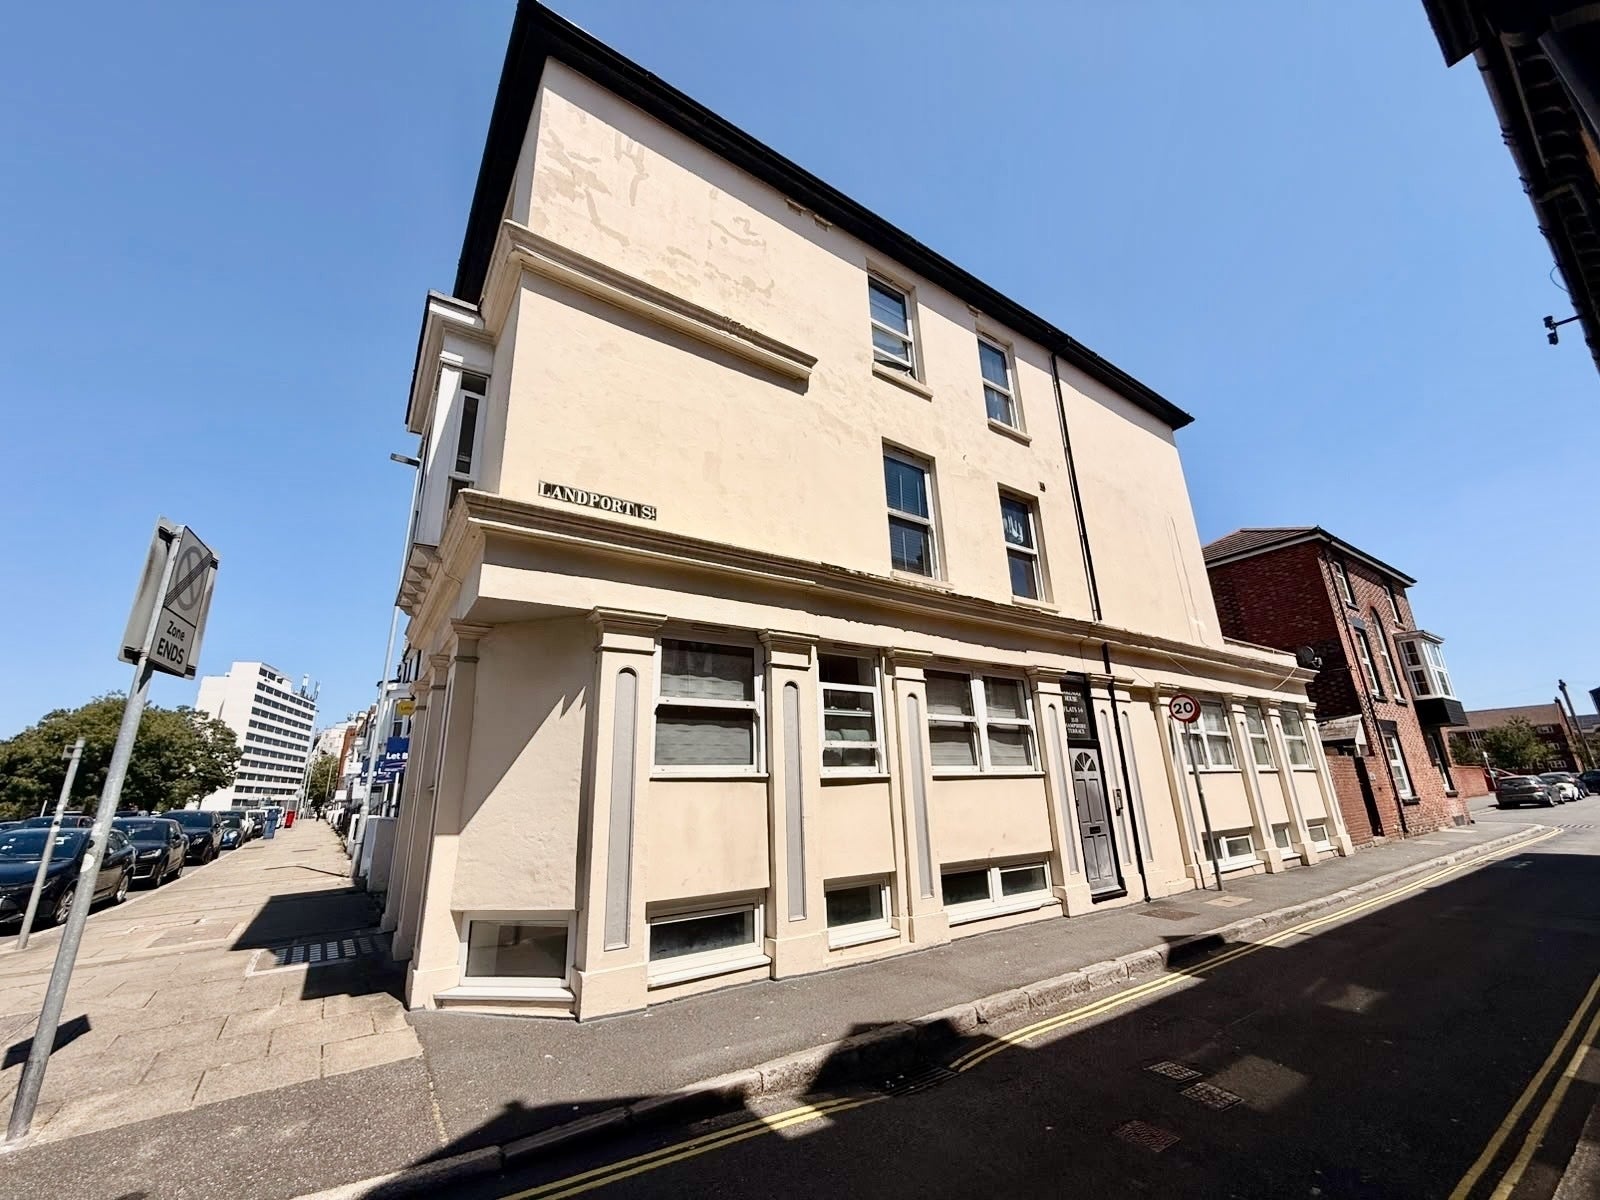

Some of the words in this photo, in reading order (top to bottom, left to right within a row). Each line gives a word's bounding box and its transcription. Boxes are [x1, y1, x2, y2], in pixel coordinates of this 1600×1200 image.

[539, 482, 634, 515] LANDPORT
[166, 621, 185, 642] Zone
[156, 638, 184, 665] ENDS
[1173, 702, 1194, 714] 20
[386, 752, 400, 760] Let
